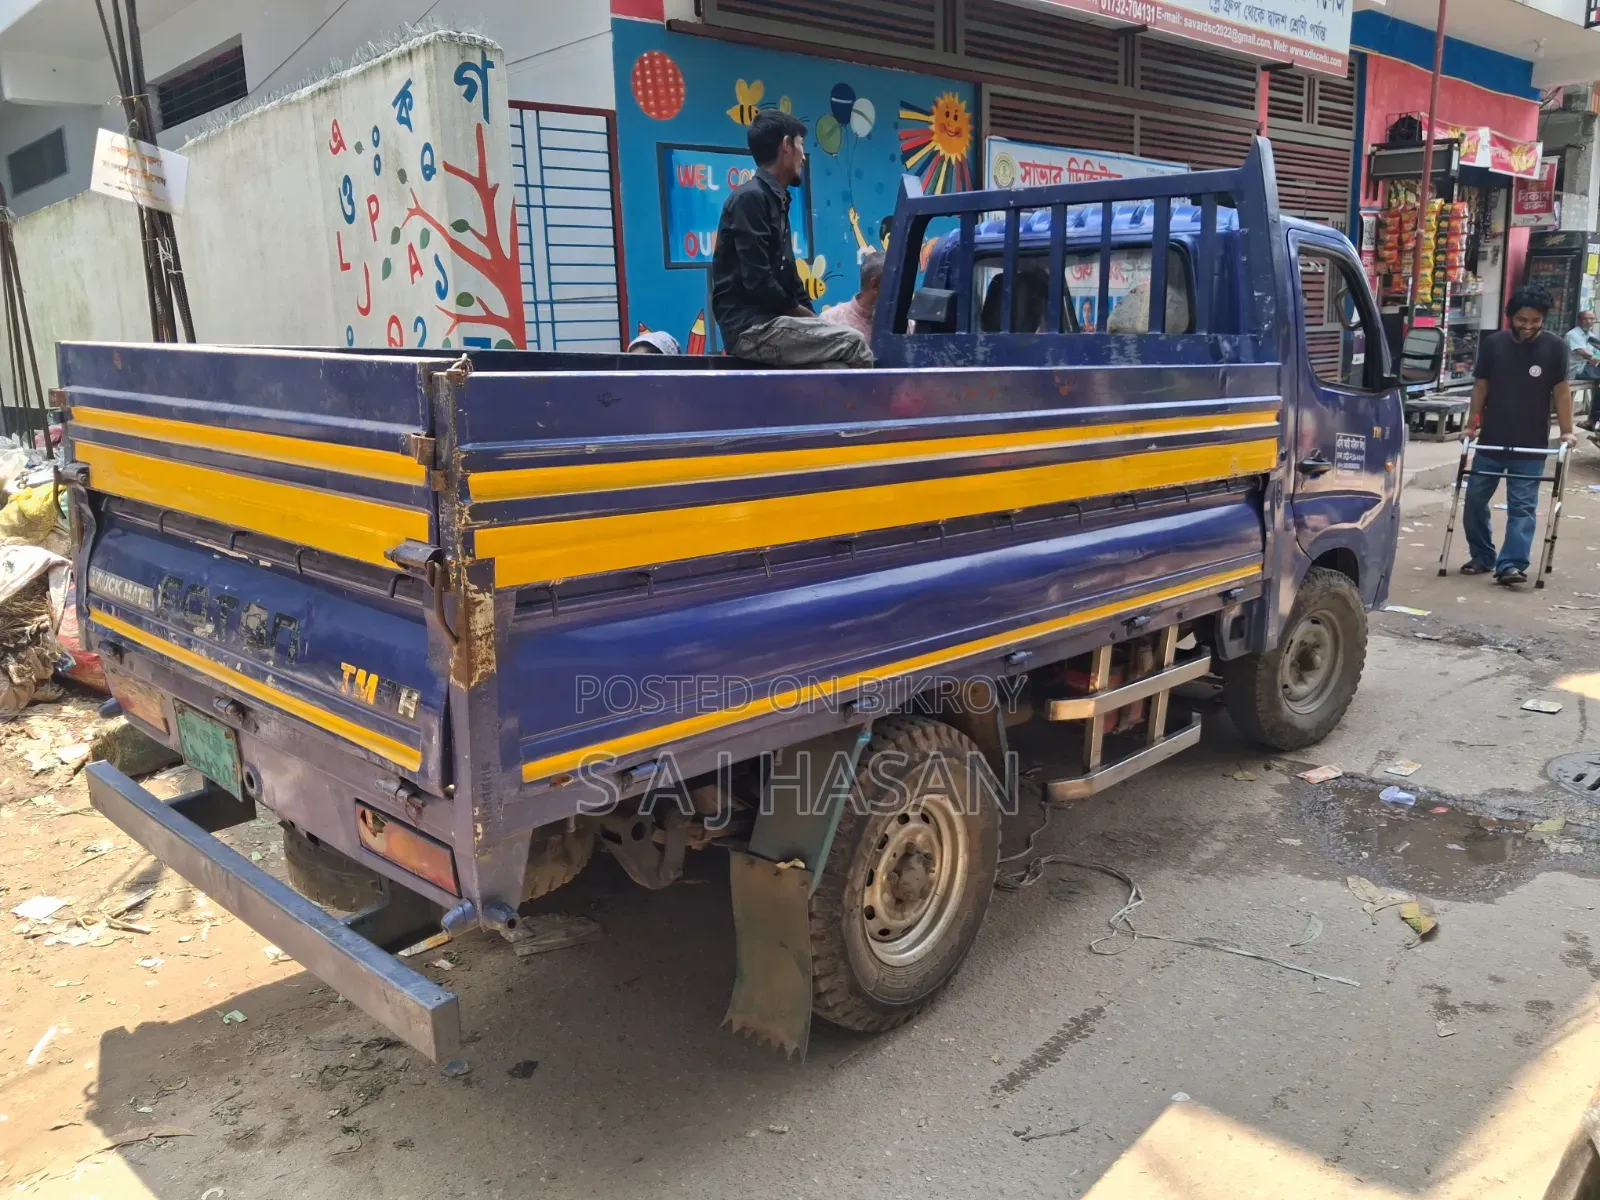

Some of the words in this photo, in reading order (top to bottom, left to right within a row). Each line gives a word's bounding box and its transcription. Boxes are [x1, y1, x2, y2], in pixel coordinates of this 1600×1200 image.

[1100, 0, 1155, 23] 01732-704131
[1156, 7, 1182, 25] E-mail:
[1273, 39, 1289, 53] Web:
[1244, 4, 1265, 24] থেকে
[1267, 10, 1288, 32] দ্বাদশ
[453, 51, 495, 125] গ
[677, 164, 719, 191] WEL
[728, 167, 757, 191] CO
[366, 193, 380, 243] P
[337, 231, 352, 271] L
[407, 242, 424, 285] A
[684, 231, 717, 258] OU
